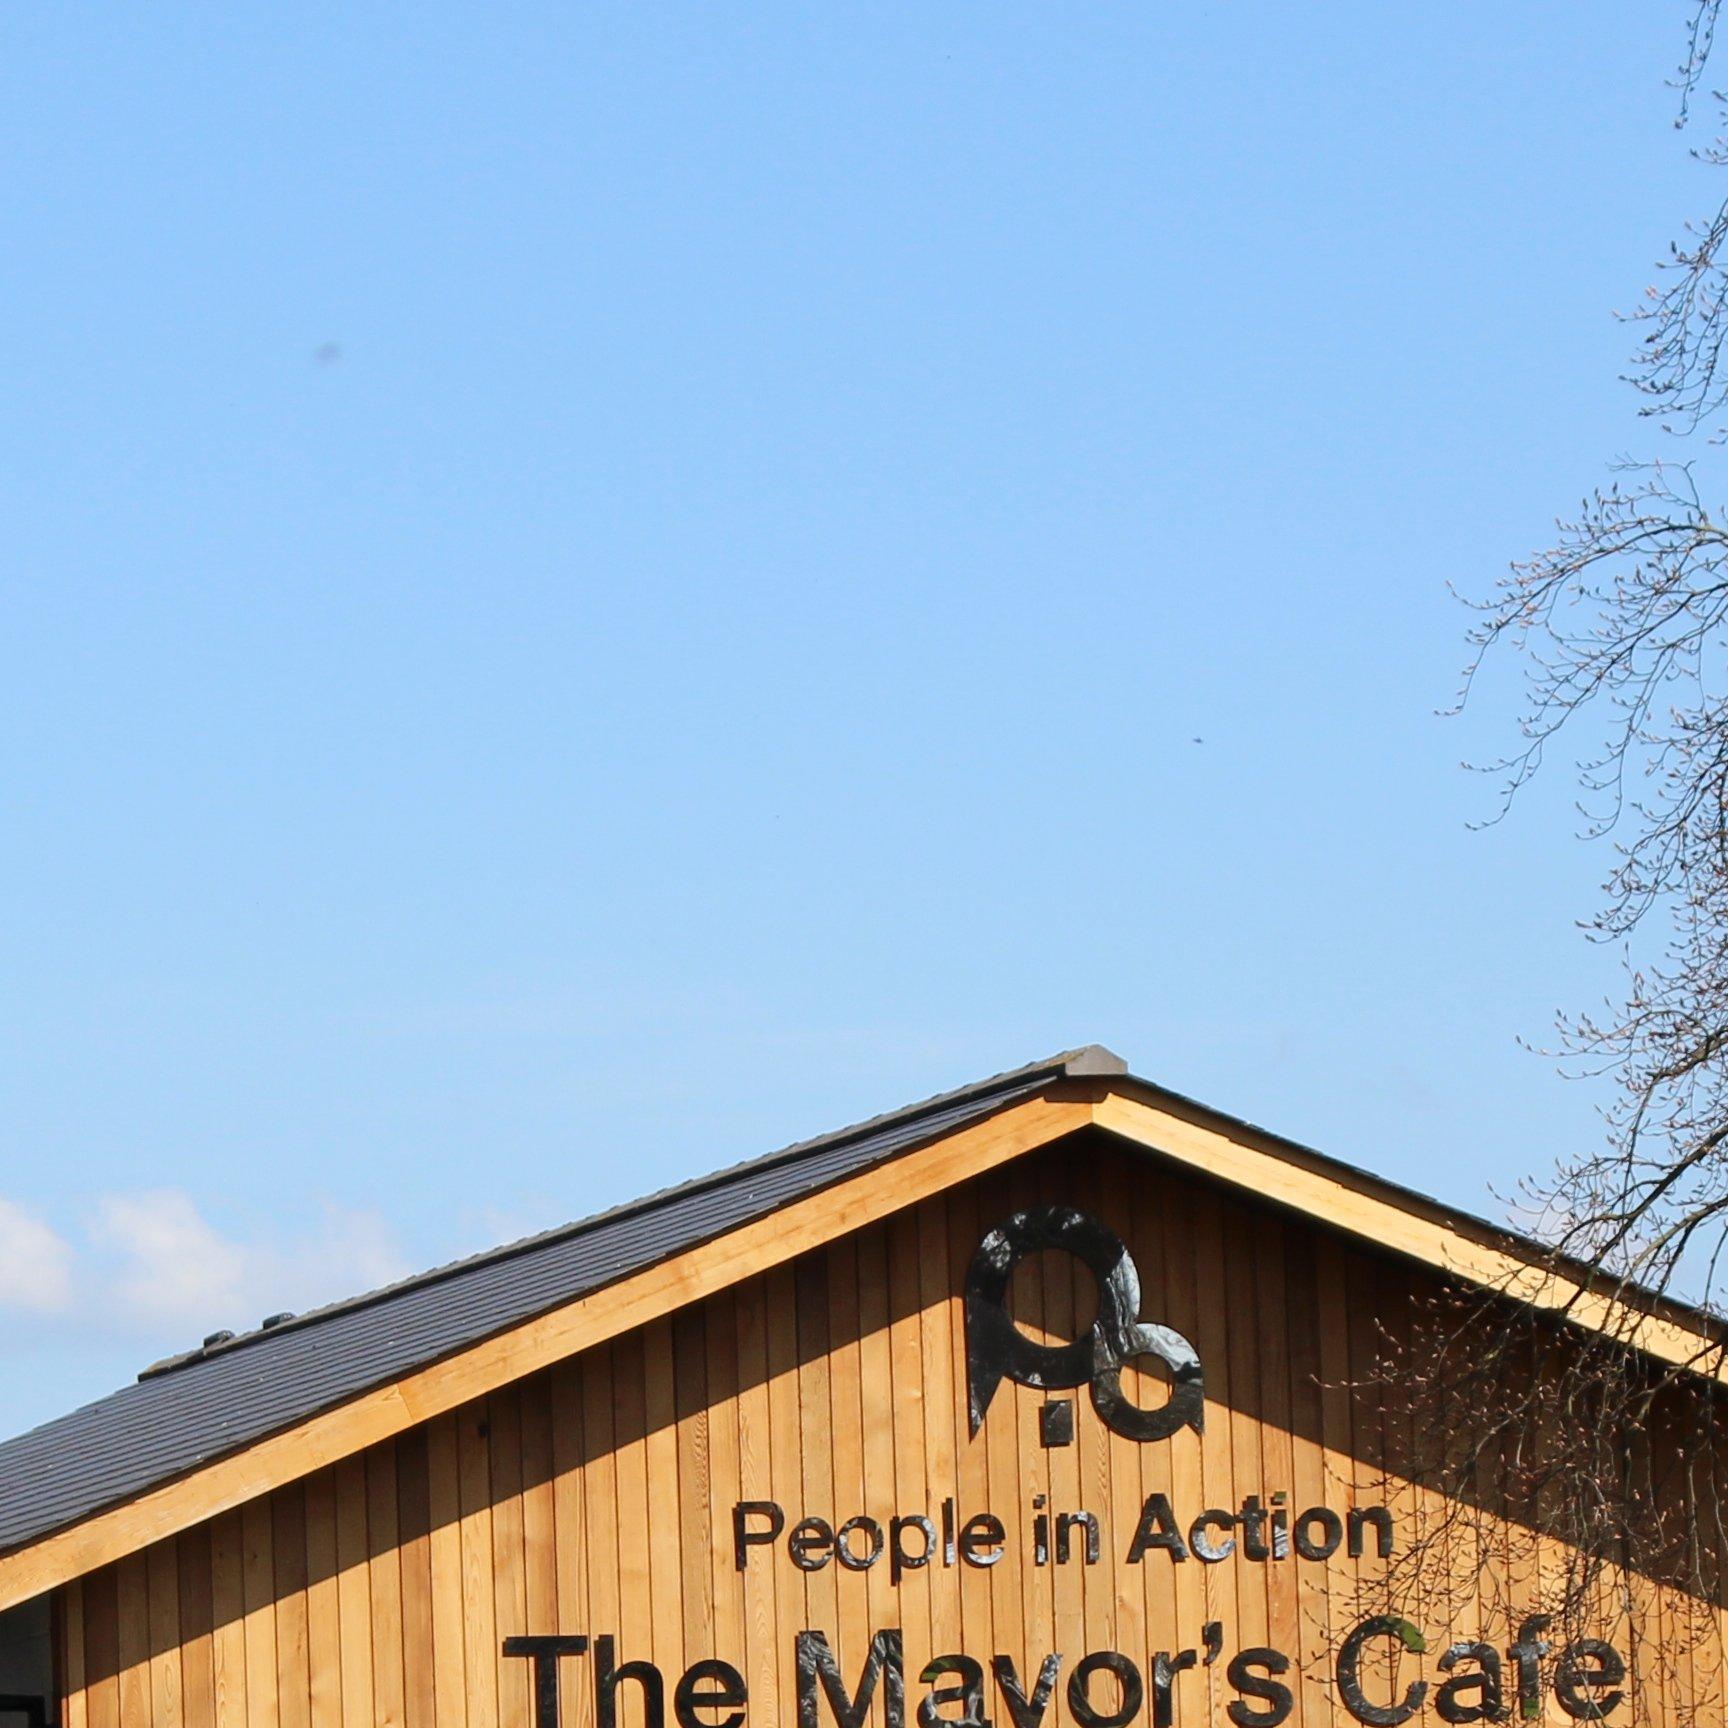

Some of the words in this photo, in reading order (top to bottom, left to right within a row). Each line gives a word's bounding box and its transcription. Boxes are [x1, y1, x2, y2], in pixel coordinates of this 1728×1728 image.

[733, 1496, 1006, 1586] People
[1032, 1494, 1100, 1566] in
[1126, 1491, 1396, 1564] Action
[1336, 1613, 1627, 1728] Cafe
